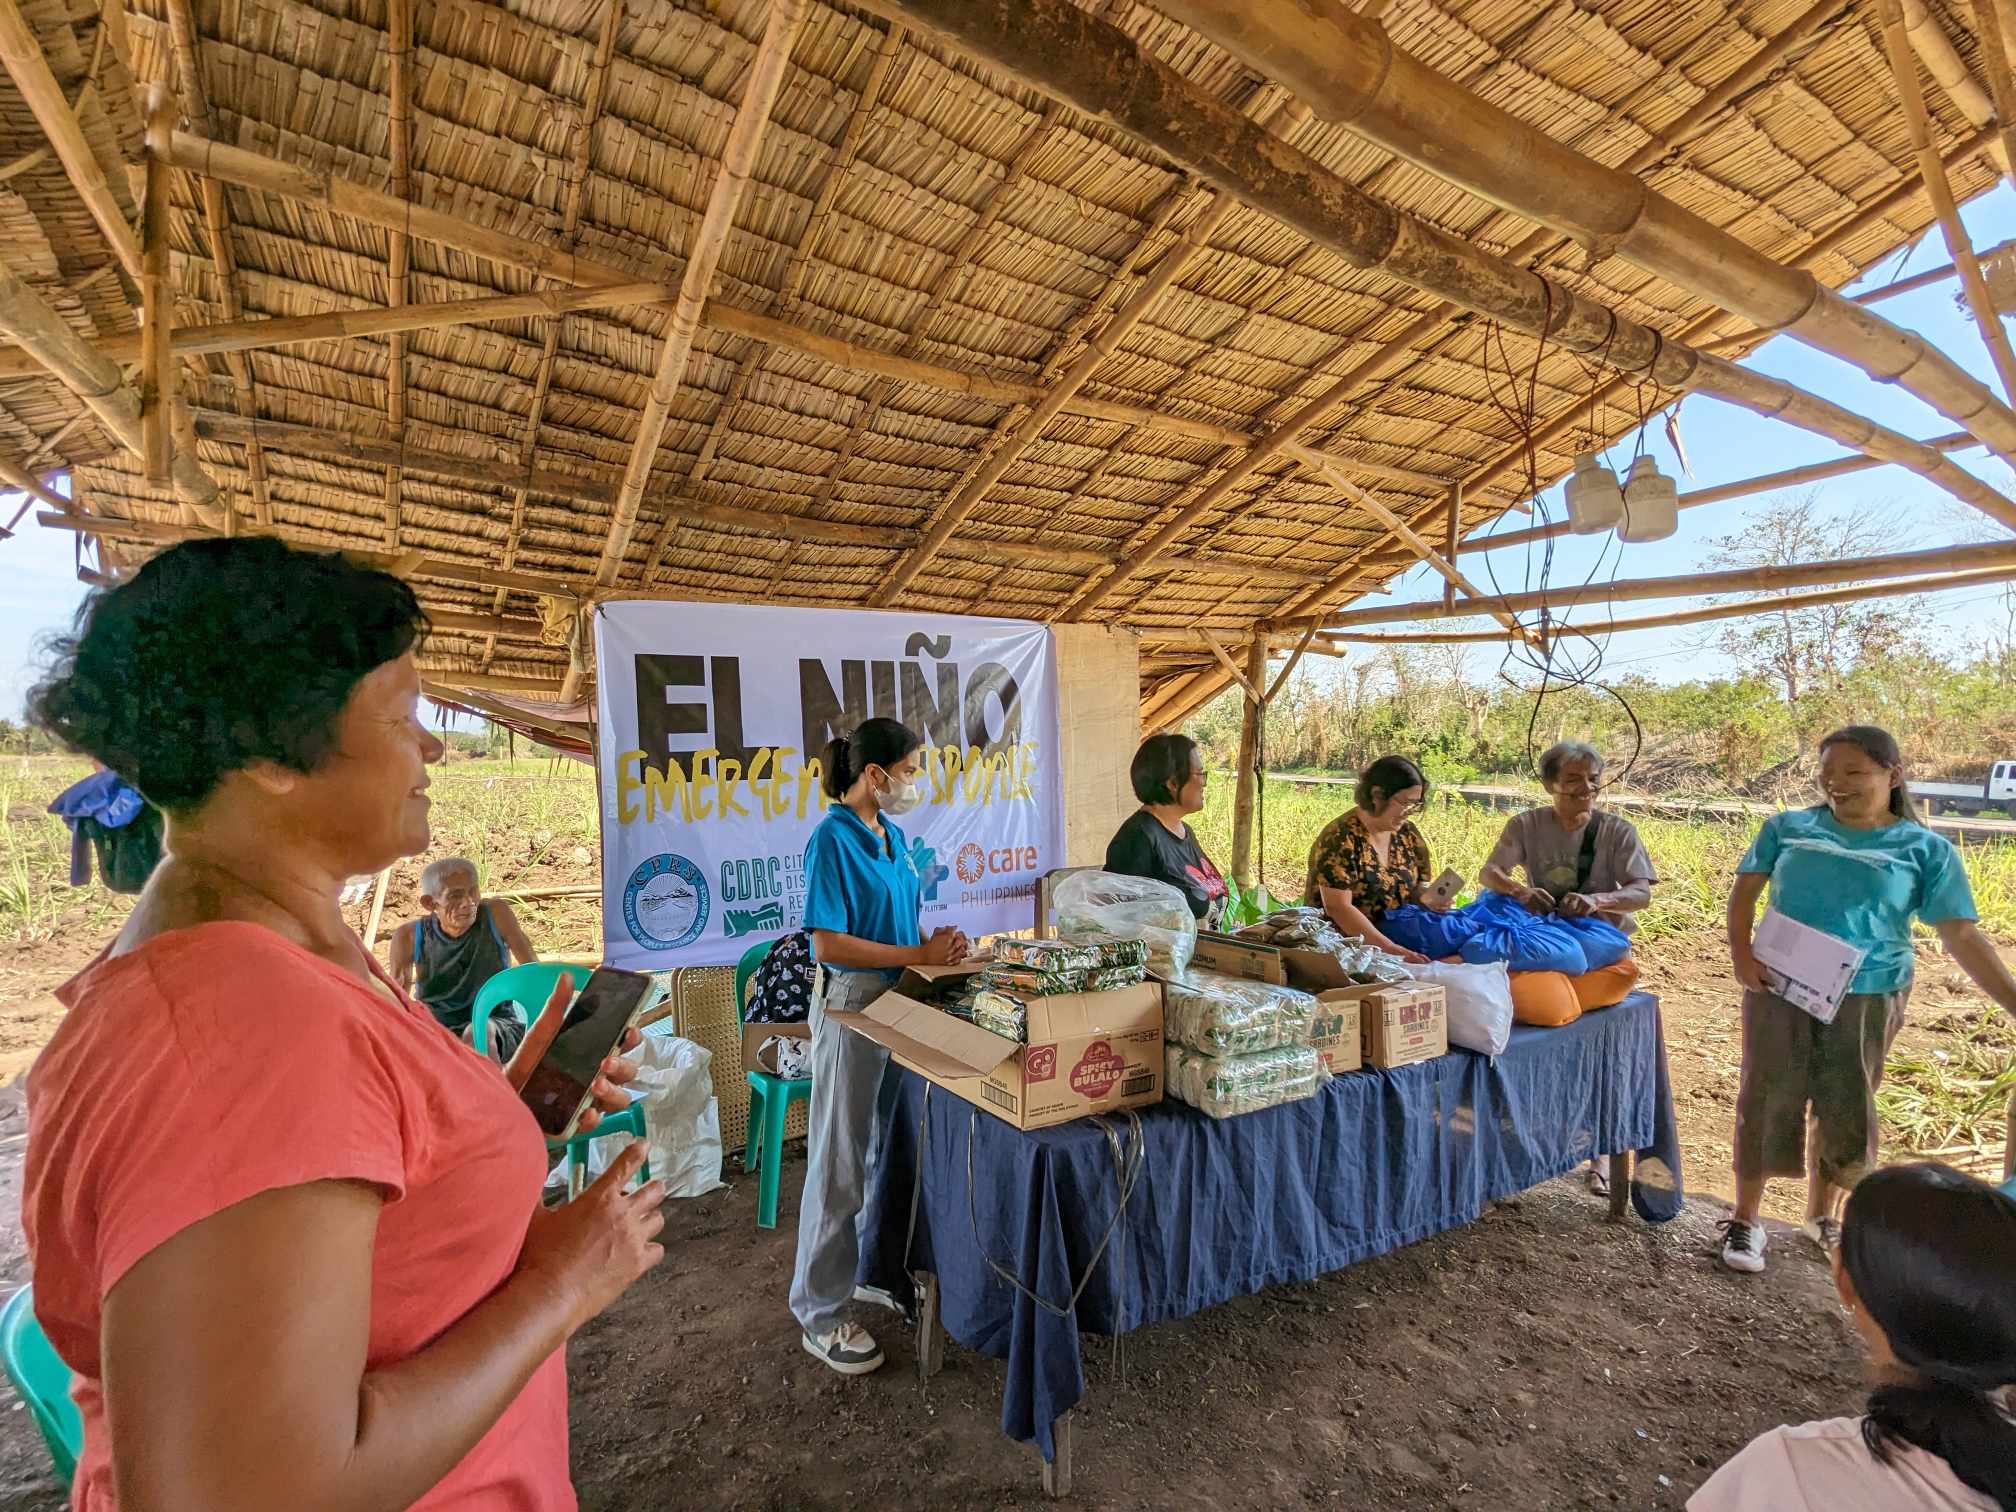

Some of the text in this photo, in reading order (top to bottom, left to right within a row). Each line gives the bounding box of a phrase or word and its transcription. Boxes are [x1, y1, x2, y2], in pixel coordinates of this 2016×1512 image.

[634, 630, 1022, 784] EL NIÑO
[617, 742, 1040, 825] EMERGEN ESPONSE
[634, 856, 699, 886] CPRS
[988, 845, 1038, 874] care
[720, 856, 783, 903] CDRC
[1073, 1069, 1120, 1088] BULALO
[1080, 1060, 1115, 1076] SPICY
